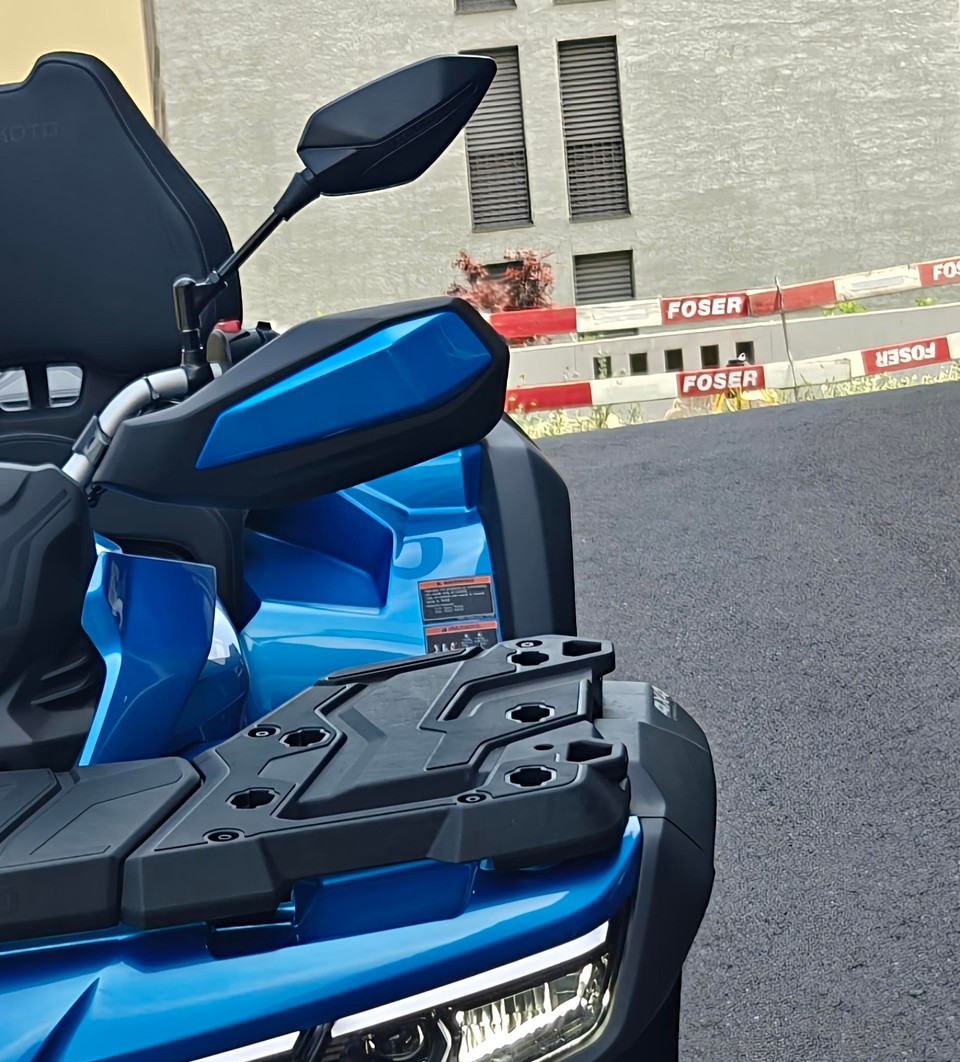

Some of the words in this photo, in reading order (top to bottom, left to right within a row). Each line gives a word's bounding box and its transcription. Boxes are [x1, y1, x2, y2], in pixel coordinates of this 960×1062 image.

[667, 296, 742, 320] FOSER
[875, 341, 936, 368] FOSER
[682, 369, 758, 393] FOSER
